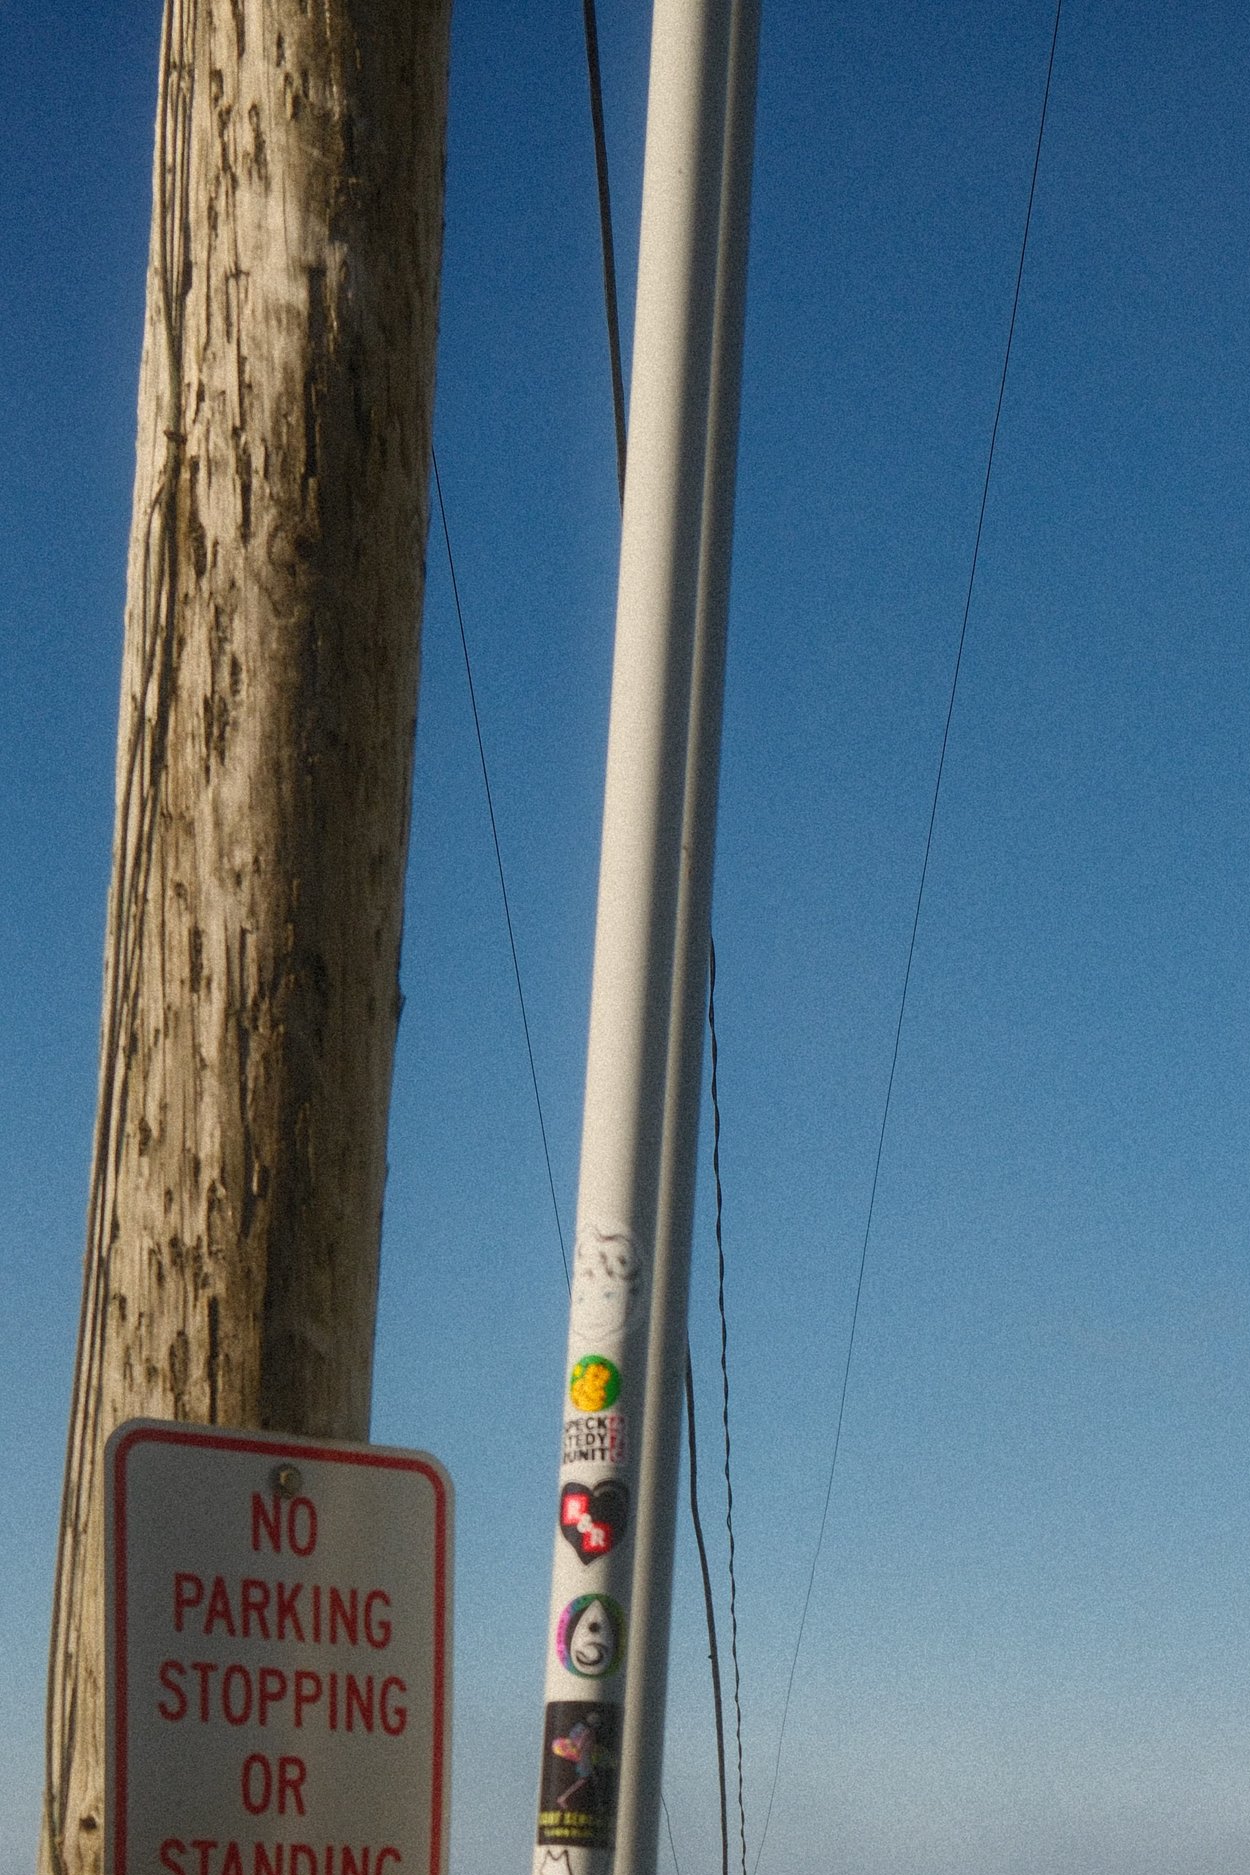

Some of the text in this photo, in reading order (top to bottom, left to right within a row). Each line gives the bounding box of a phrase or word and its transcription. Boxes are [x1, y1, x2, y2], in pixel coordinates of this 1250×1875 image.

[250, 1493, 317, 1557] NO
[173, 1572, 393, 1650] PARKING
[158, 1661, 408, 1736] STOPPING
[240, 1752, 308, 1815] OR
